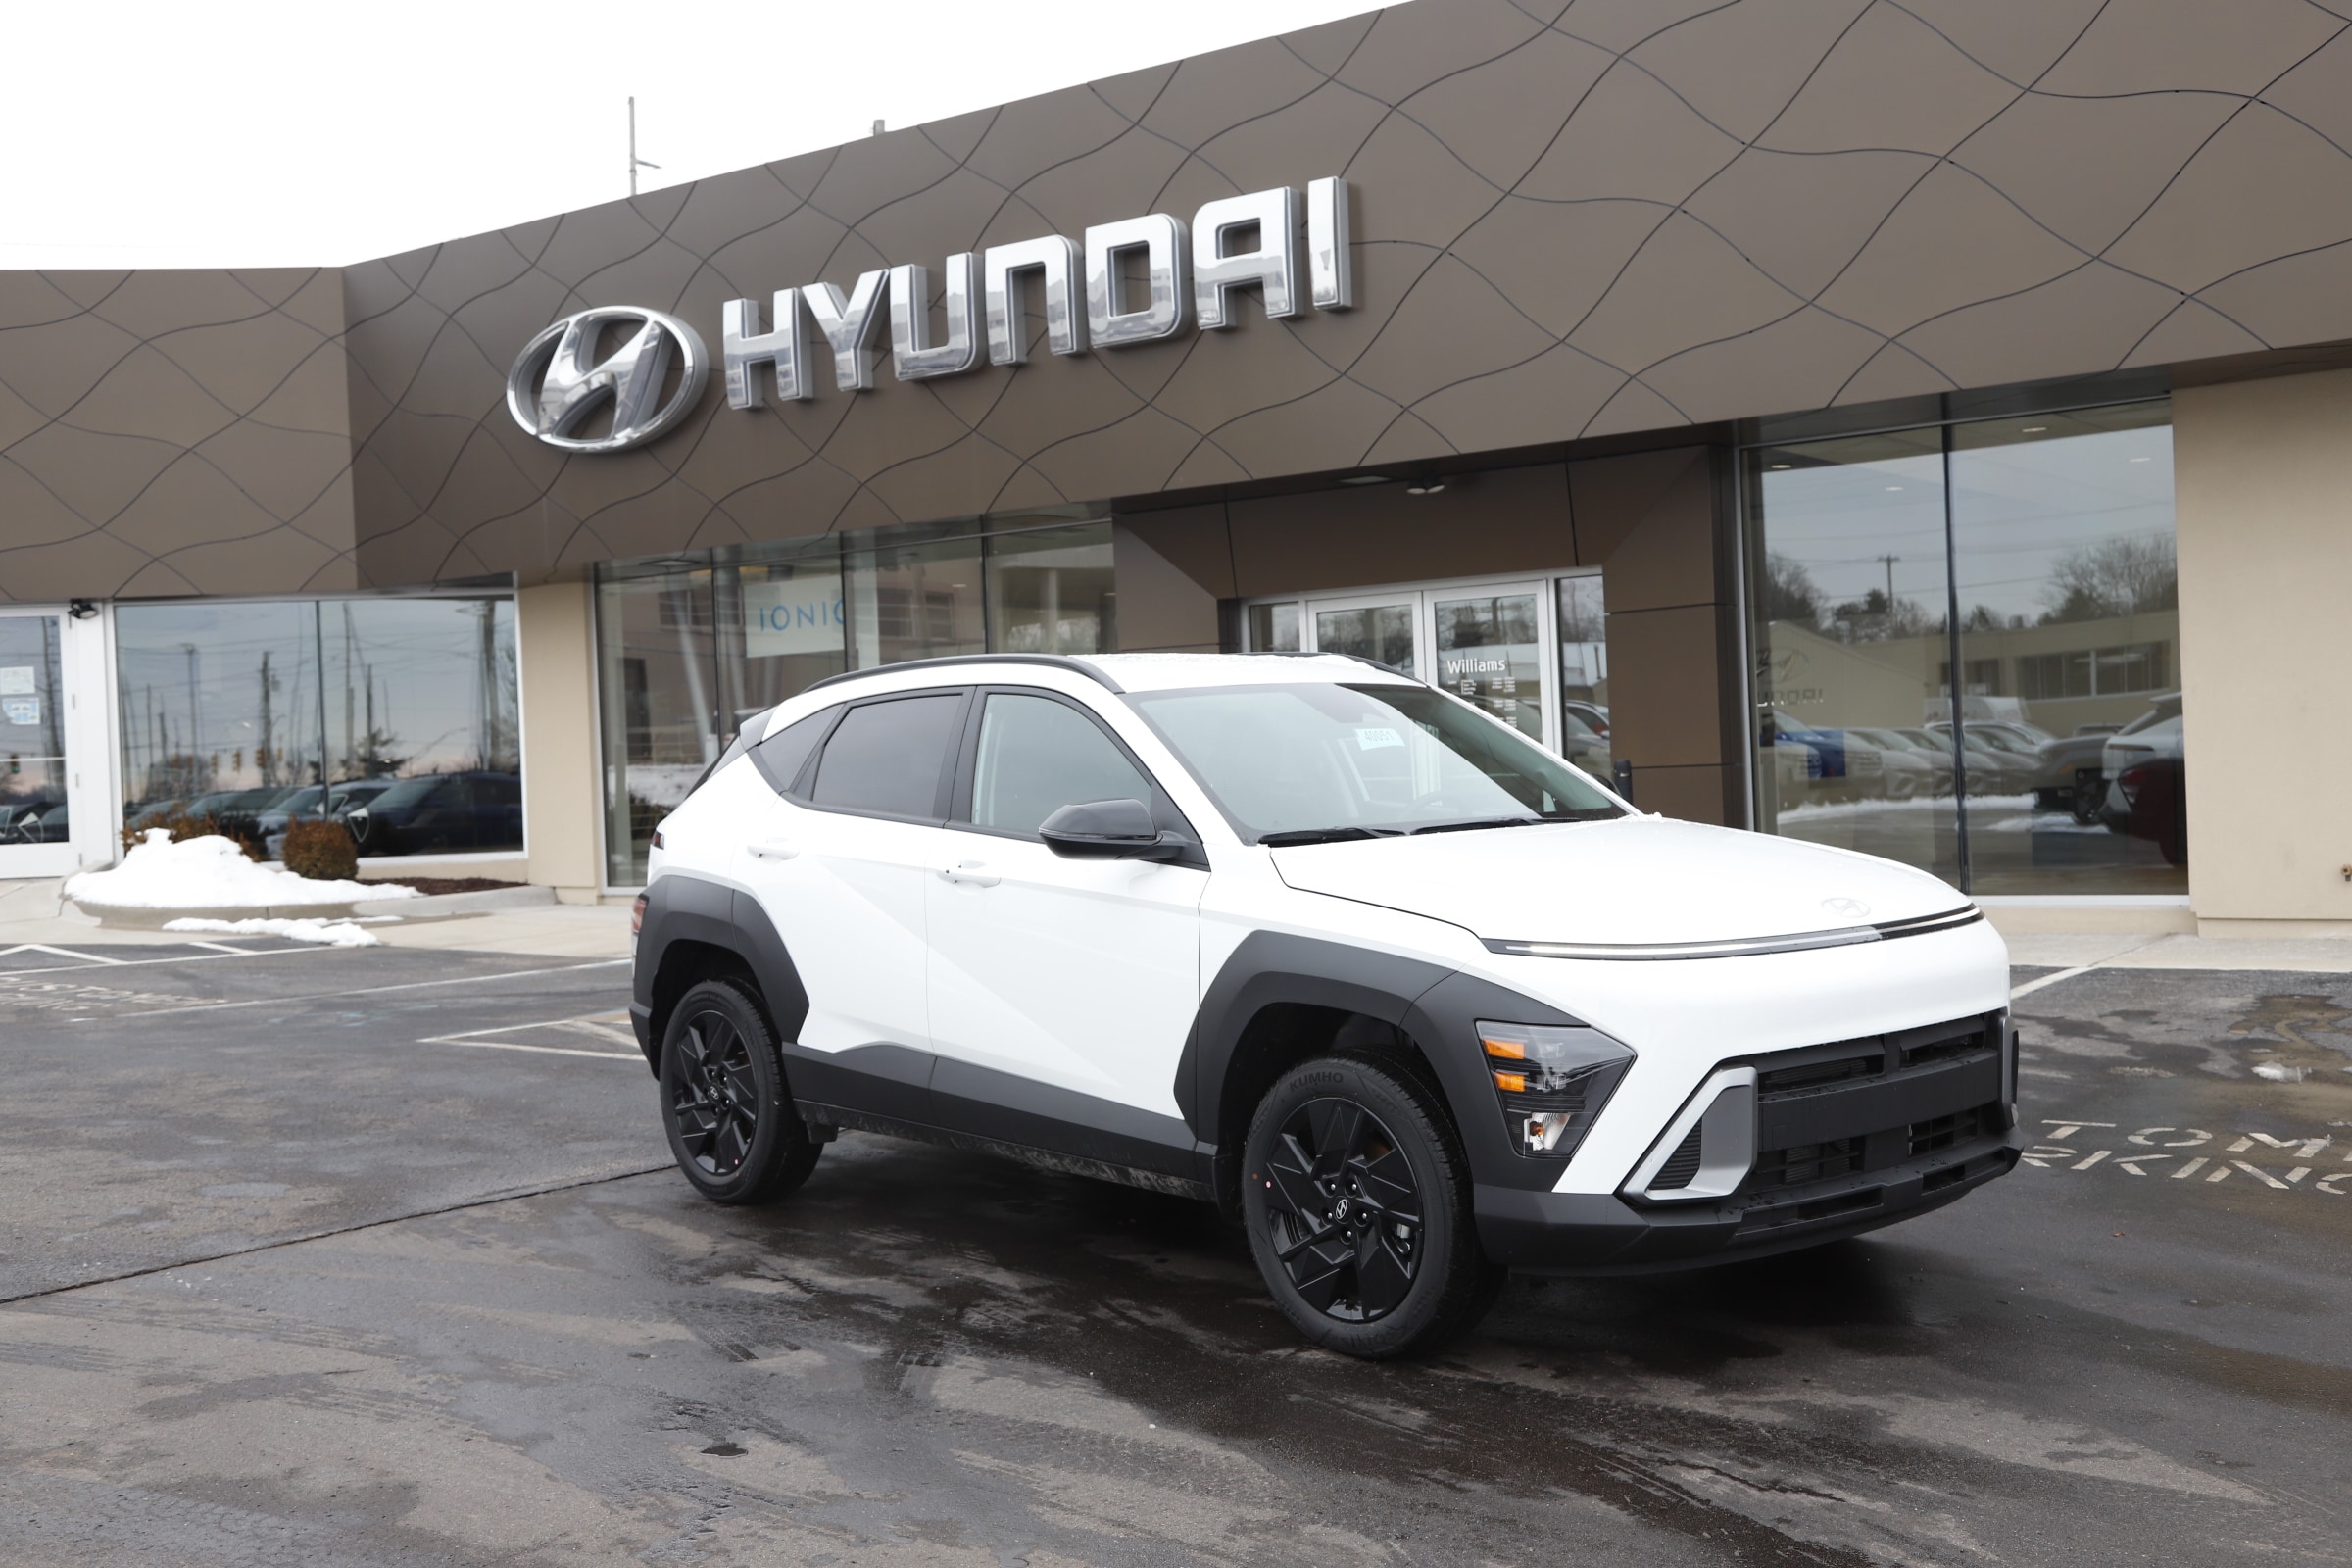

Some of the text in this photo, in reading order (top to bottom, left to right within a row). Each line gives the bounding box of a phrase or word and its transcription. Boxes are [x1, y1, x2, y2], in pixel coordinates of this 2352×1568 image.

[723, 175, 1352, 410] HYUNDAI
[1447, 658, 1506, 674] Williams
[1288, 1071, 1344, 1092] KUMHO
